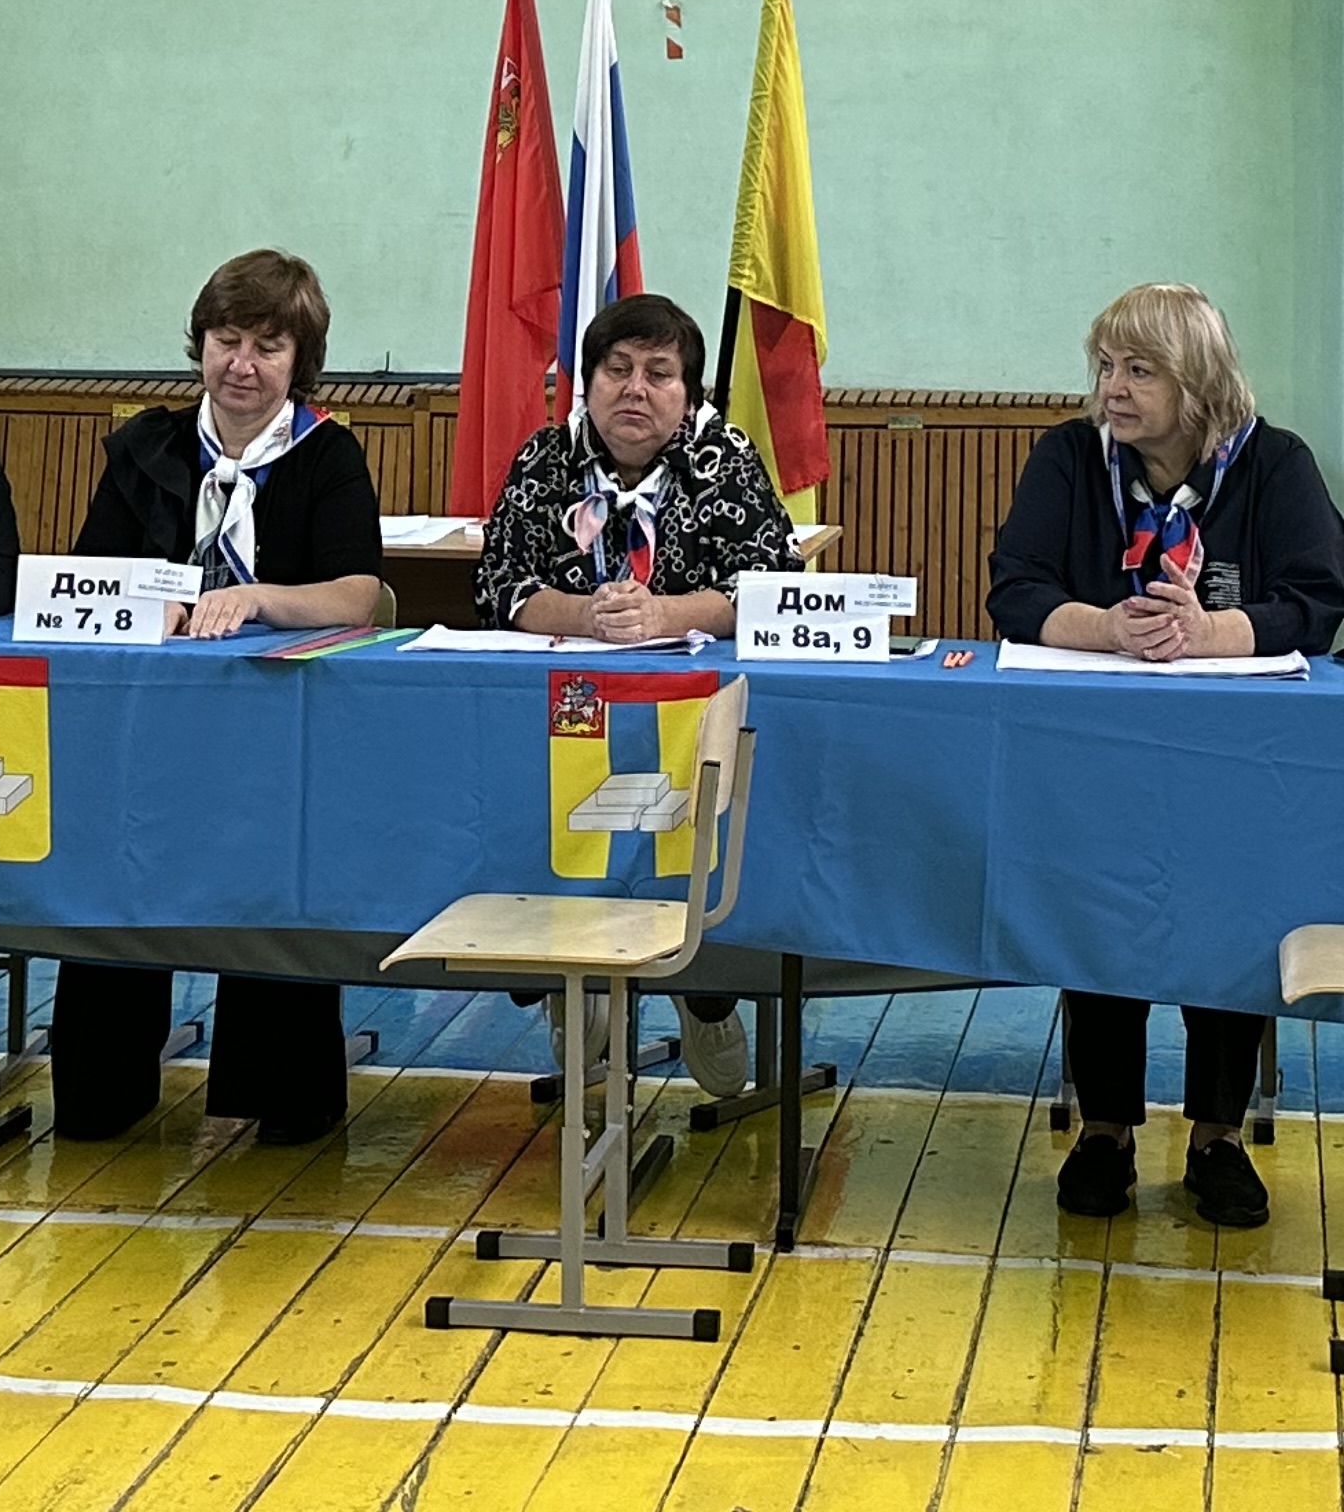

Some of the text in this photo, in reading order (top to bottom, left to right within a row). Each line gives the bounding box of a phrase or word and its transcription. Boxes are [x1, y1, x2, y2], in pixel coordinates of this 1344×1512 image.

[50, 573, 121, 598] Дом
[777, 586, 846, 615] Дом
[36, 607, 133, 635] № 7, 8
[754, 624, 872, 654] № 8а, 9
